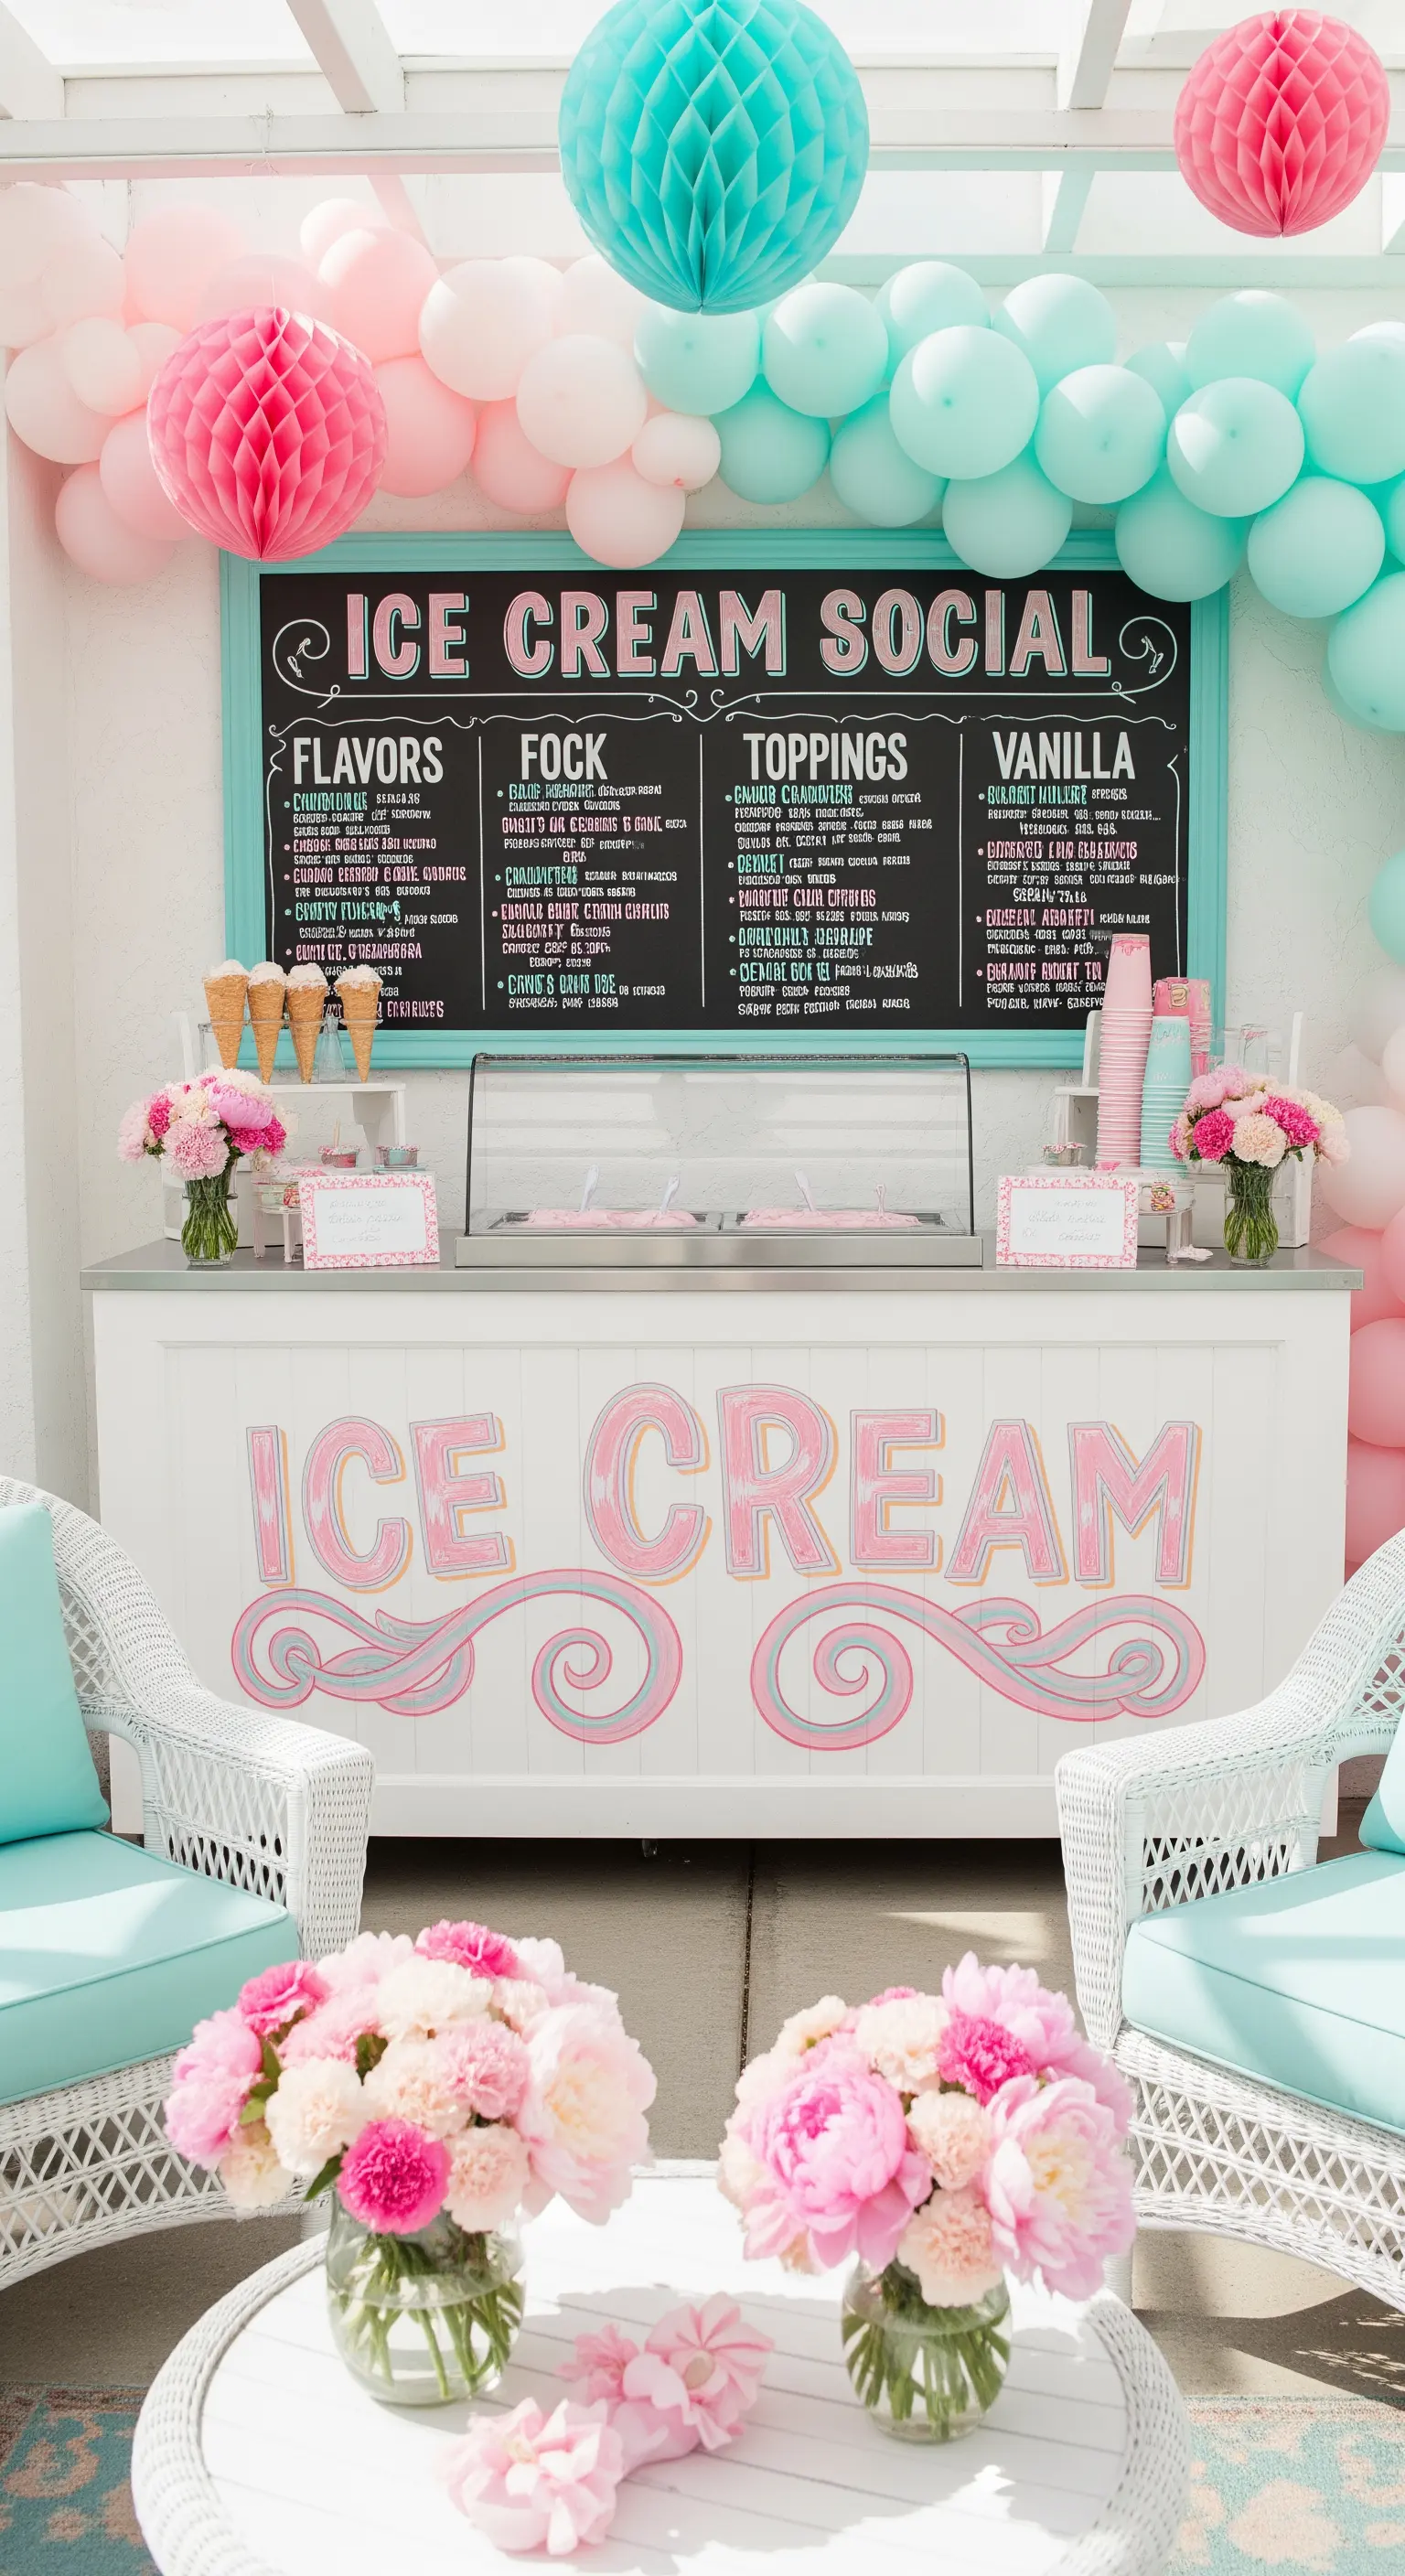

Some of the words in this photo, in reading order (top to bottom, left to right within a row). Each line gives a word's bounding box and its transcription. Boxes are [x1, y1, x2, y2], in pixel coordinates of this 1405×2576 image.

[347, 592, 470, 680] ICE
[503, 590, 787, 680] CREAM
[820, 588, 1112, 678] SOCIAL
[293, 735, 444, 785] FLAVORS
[520, 733, 608, 781] FOCK
[742, 732, 908, 781] TOPPINGS
[992, 731, 1136, 780] VANILLA
[245, 1411, 516, 1594] ICE
[584, 1381, 1202, 1591] CREAM
